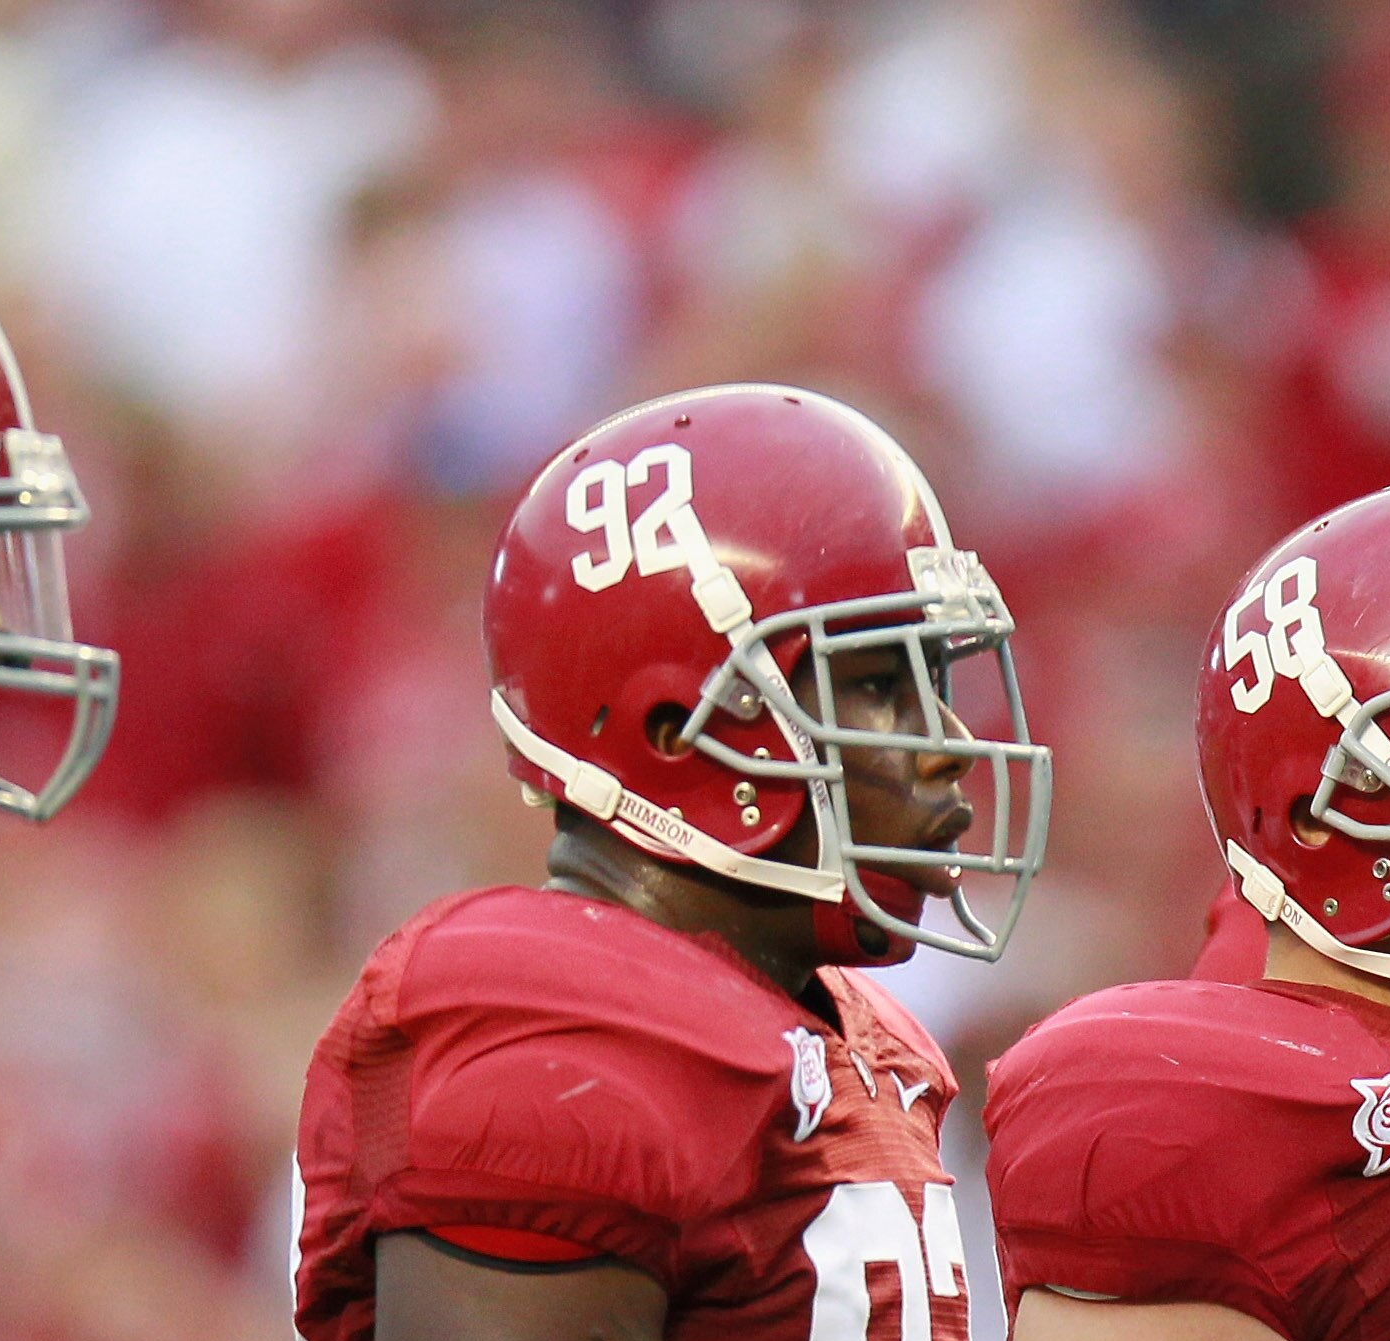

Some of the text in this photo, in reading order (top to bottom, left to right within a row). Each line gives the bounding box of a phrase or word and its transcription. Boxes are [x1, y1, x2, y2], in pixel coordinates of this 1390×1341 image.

[566, 442, 694, 592] 92
[1224, 555, 1323, 714] 58
[618, 794, 695, 846] RIMSON
